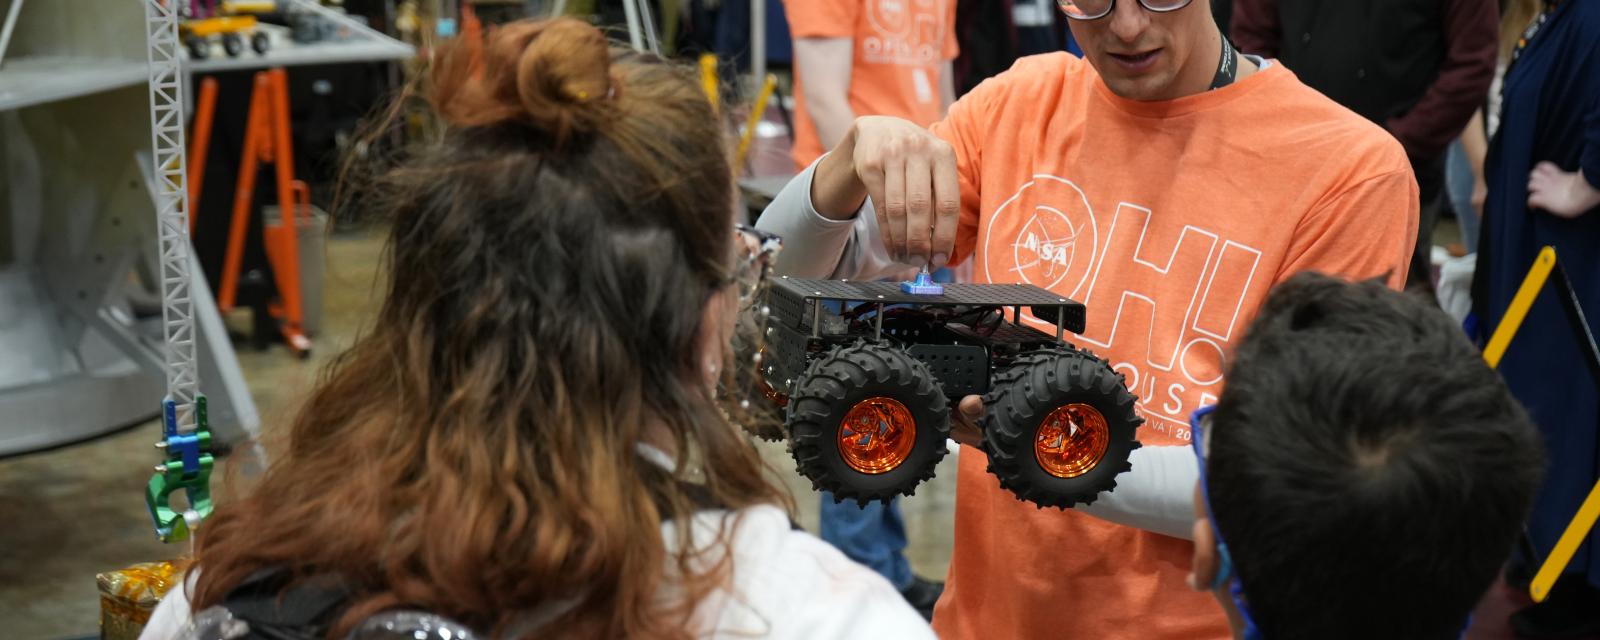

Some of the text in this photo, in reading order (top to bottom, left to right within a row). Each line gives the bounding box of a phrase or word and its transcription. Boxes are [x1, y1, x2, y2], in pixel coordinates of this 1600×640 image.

[1096, 354, 1218, 415] OUS
[1152, 419, 1192, 441] VA 20
